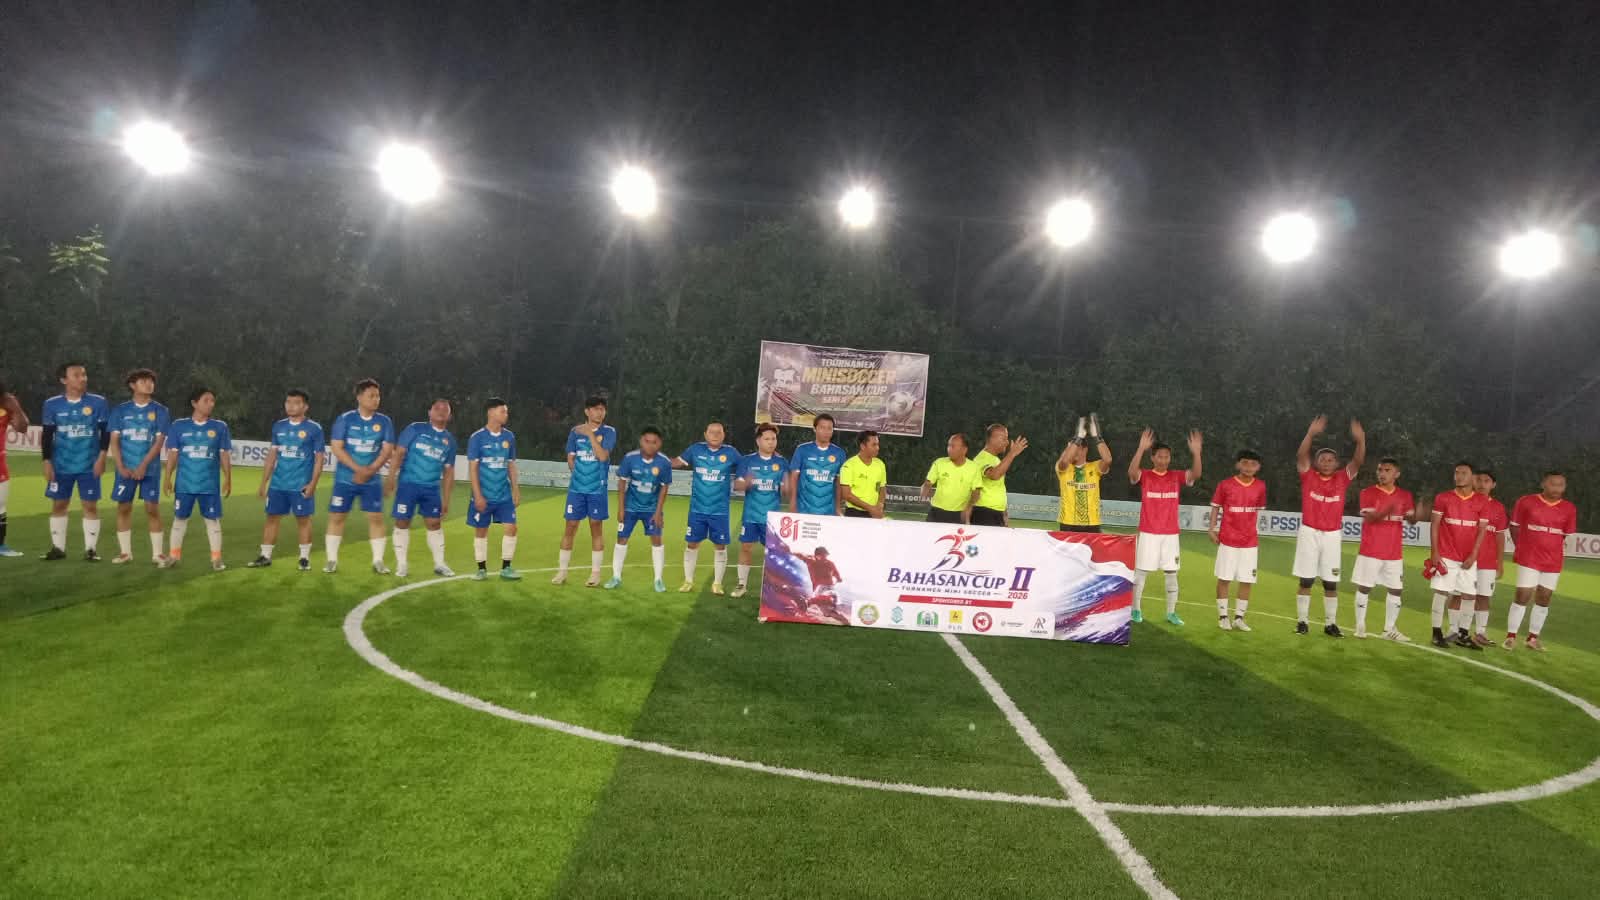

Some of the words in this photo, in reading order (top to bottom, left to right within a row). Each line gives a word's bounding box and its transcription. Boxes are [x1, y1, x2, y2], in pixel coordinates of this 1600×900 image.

[802, 367, 897, 384] MINISOCCER
[810, 384, 865, 395] BAHASAN
[865, 385, 888, 396] CUP
[241, 446, 270, 461] PSS
[117, 485, 125, 496] 7
[1270, 516, 1300, 531] PSSI
[888, 567, 969, 587] BAHASAN
[972, 575, 1006, 590] CUP
[1008, 592, 1029, 600] 2026
